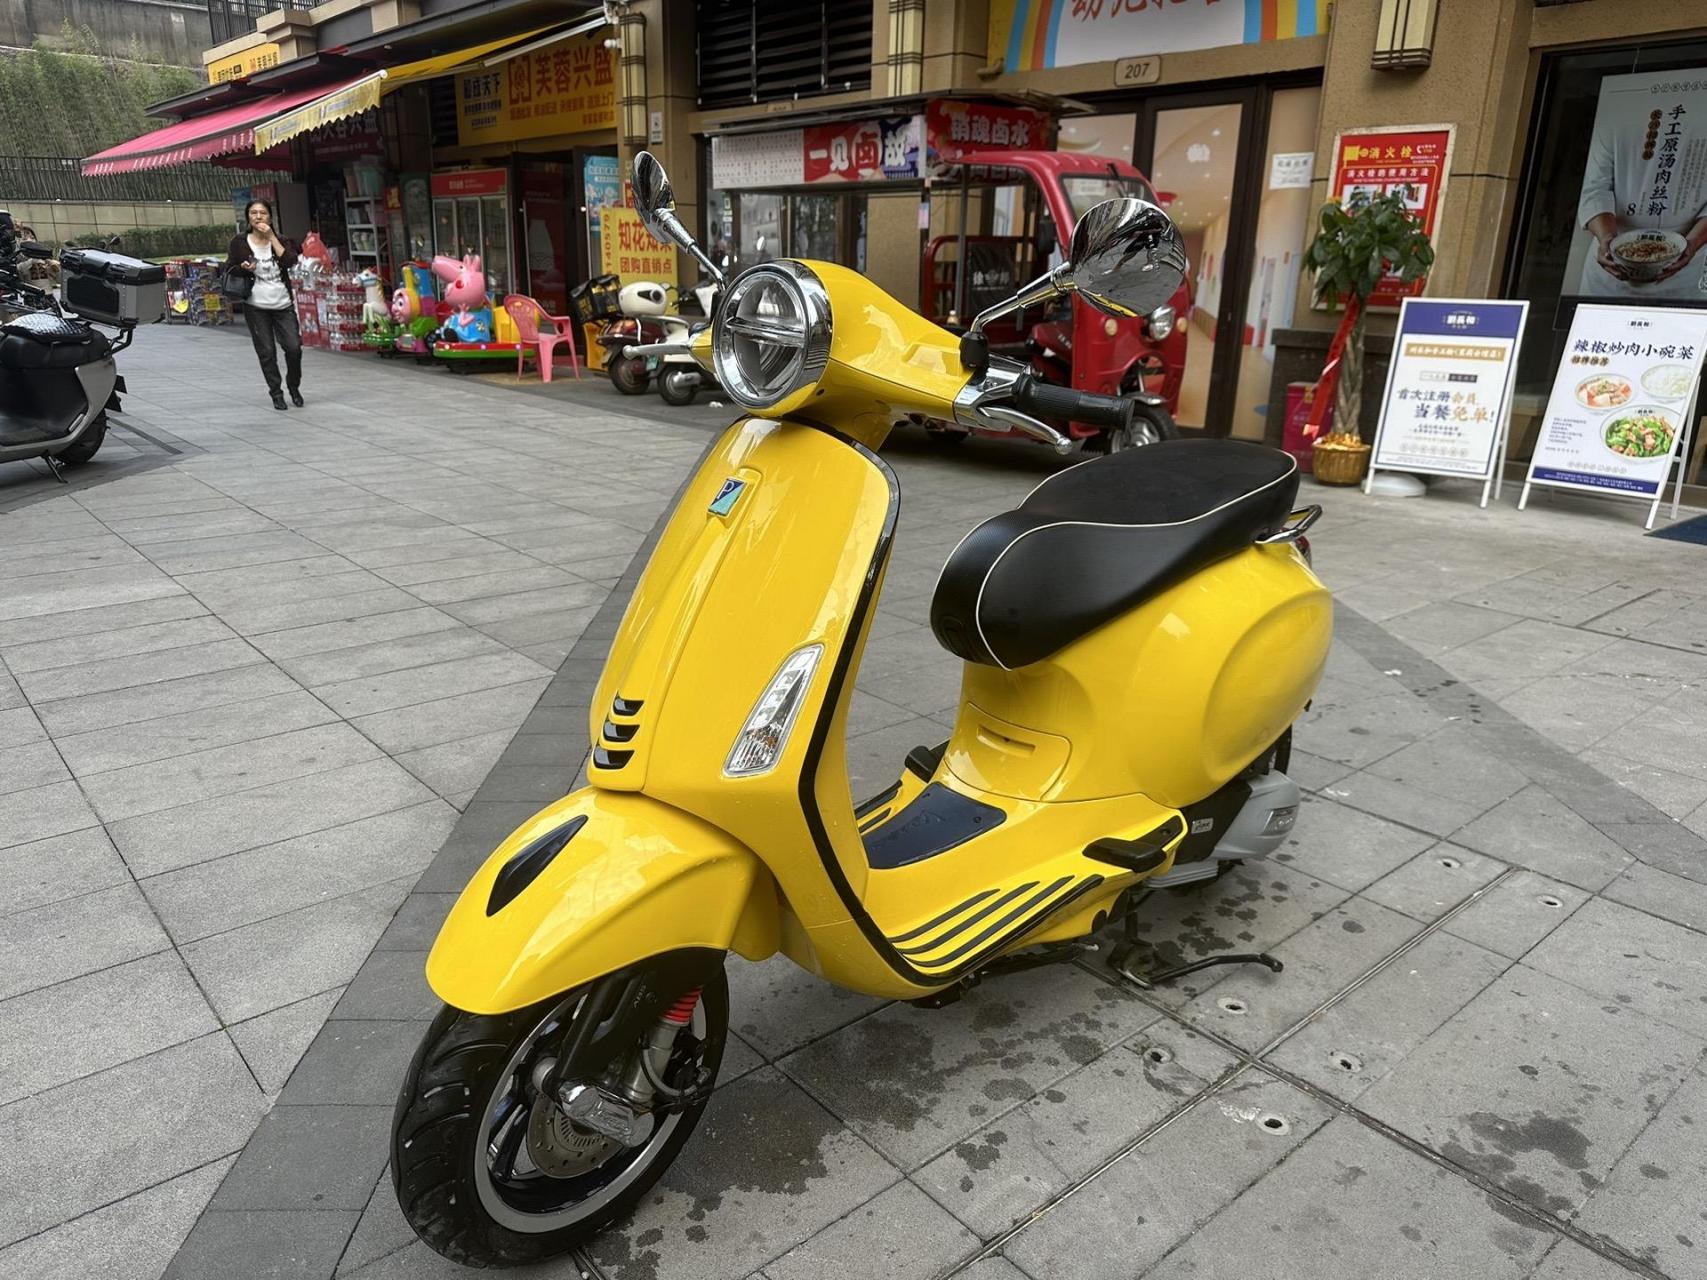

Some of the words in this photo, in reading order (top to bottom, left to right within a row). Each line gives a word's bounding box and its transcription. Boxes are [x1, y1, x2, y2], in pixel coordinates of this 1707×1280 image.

[535, 44, 613, 97] 芙蓉兴盛
[1124, 63, 1150, 79] 207
[951, 112, 1030, 147] 销魂卤水
[1369, 145, 1412, 159] 消火栓
[1648, 103, 1686, 216] 手工原汤肉丝粉
[1347, 167, 1429, 178] 消火栓的使用方法
[620, 257, 672, 275] 团购直销点
[1573, 339, 1695, 361] 辣椒炒肉小碗菜
